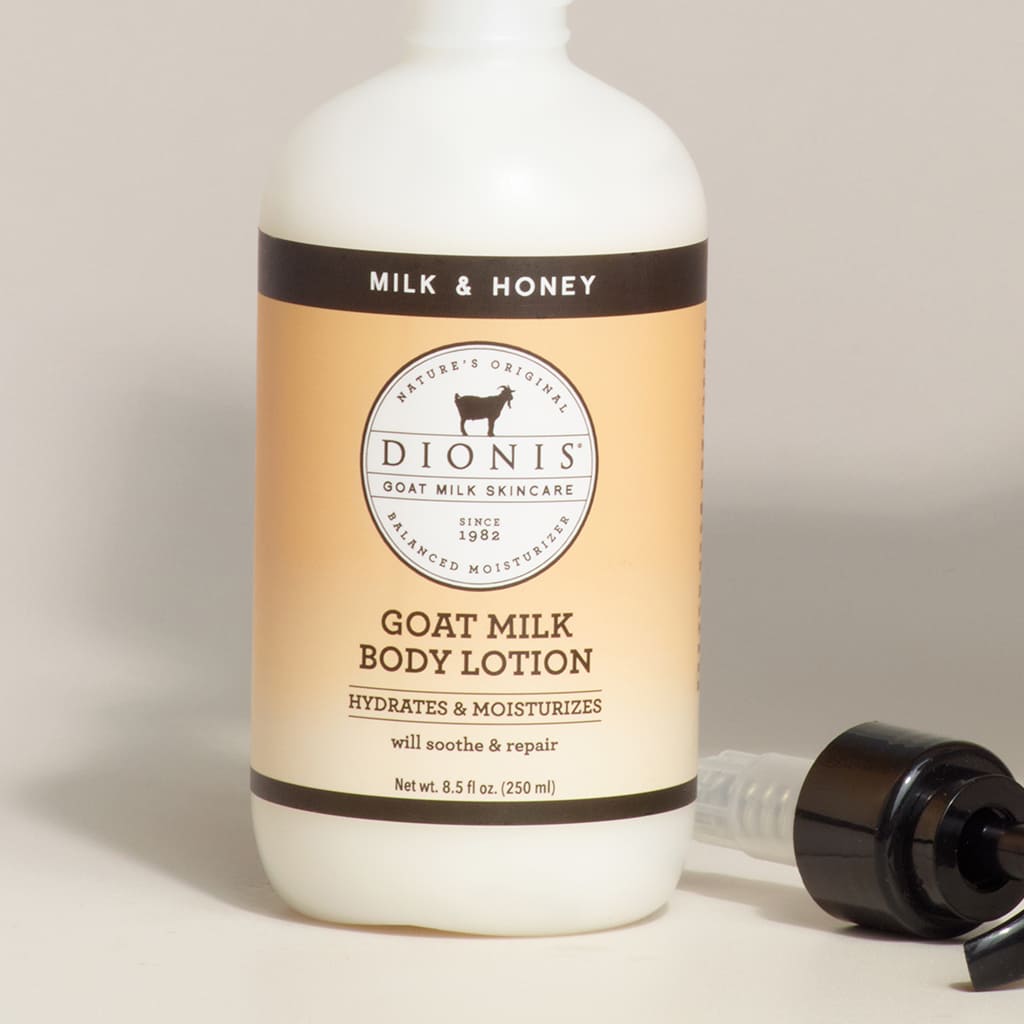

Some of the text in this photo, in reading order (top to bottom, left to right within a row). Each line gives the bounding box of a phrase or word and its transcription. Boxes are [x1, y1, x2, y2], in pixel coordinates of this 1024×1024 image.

[369, 270, 597, 297] MILK & HONEY
[396, 358, 568, 414] NATURE'S ORIGINAL
[382, 480, 574, 497] GOAT MILK SKINCARE
[459, 517, 501, 527] SINCE
[387, 511, 570, 575] BALANCED MOISTURIZER
[458, 528, 501, 543] 1982
[380, 608, 574, 640] GOAT MILK
[358, 643, 594, 677] BODY LOTION
[348, 693, 603, 718] HYDRATES & MOISTURIZES
[390, 733, 559, 757] will soothe & repair
[394, 777, 556, 798] Net wt. 8.5 fl oz. (250 ml)
